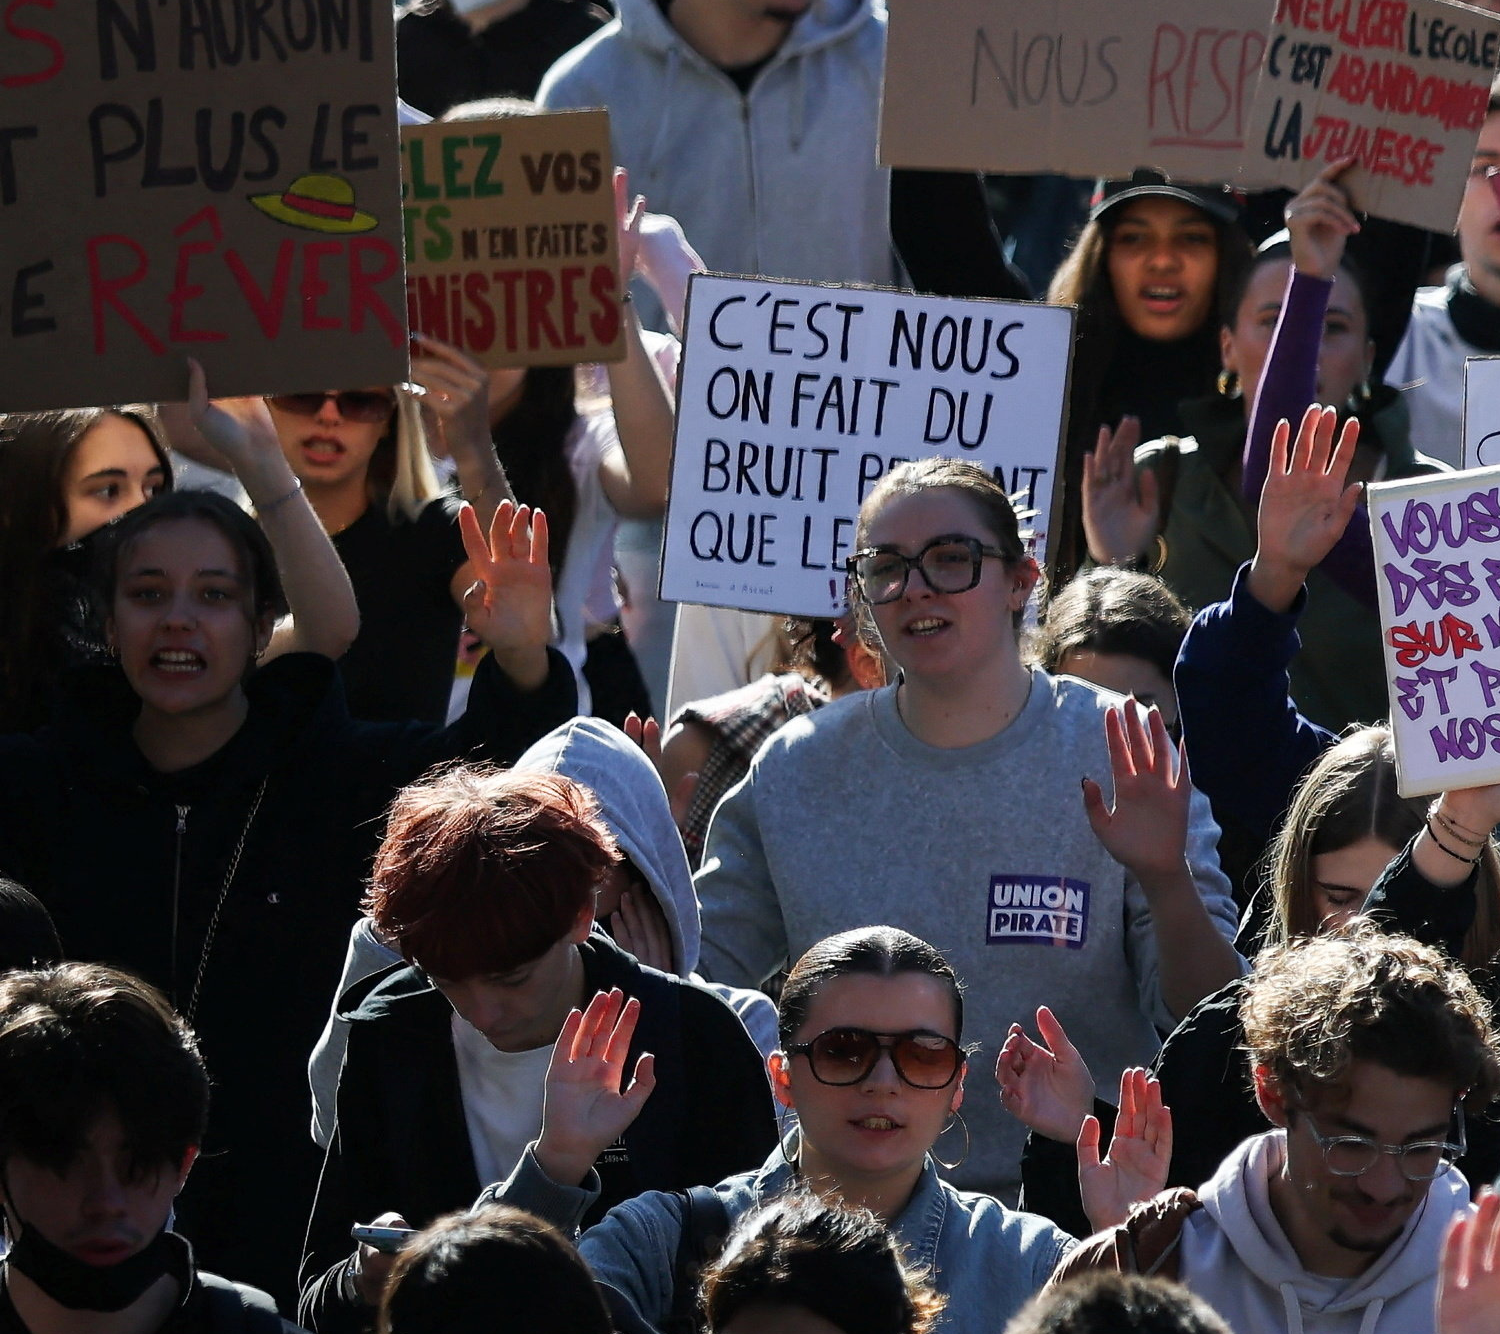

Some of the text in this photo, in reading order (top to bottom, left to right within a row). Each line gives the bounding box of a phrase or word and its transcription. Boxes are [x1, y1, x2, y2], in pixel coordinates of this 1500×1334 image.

[970, 26, 1122, 111] NOUS
[1268, 34, 1333, 89] C'EST
[1408, 10, 1499, 67] L'ECOLE
[88, 96, 382, 198] PLUS LE
[1264, 96, 1444, 186] LA JEUNESSE
[520, 150, 601, 196] VOS
[461, 226, 518, 260] N'EN
[84, 202, 402, 359] RÊVER
[708, 291, 1024, 380] C'EST NOUS
[706, 366, 993, 451] ON FAIT DU
[702, 439, 840, 503] BRUIT
[690, 510, 854, 571] QUE LE
[1383, 557, 1480, 617] DES
[1384, 611, 1484, 668] SUR
[1395, 665, 1458, 721] ET
[993, 882, 1084, 912] UNION
[994, 912, 1080, 939] PIRATE
